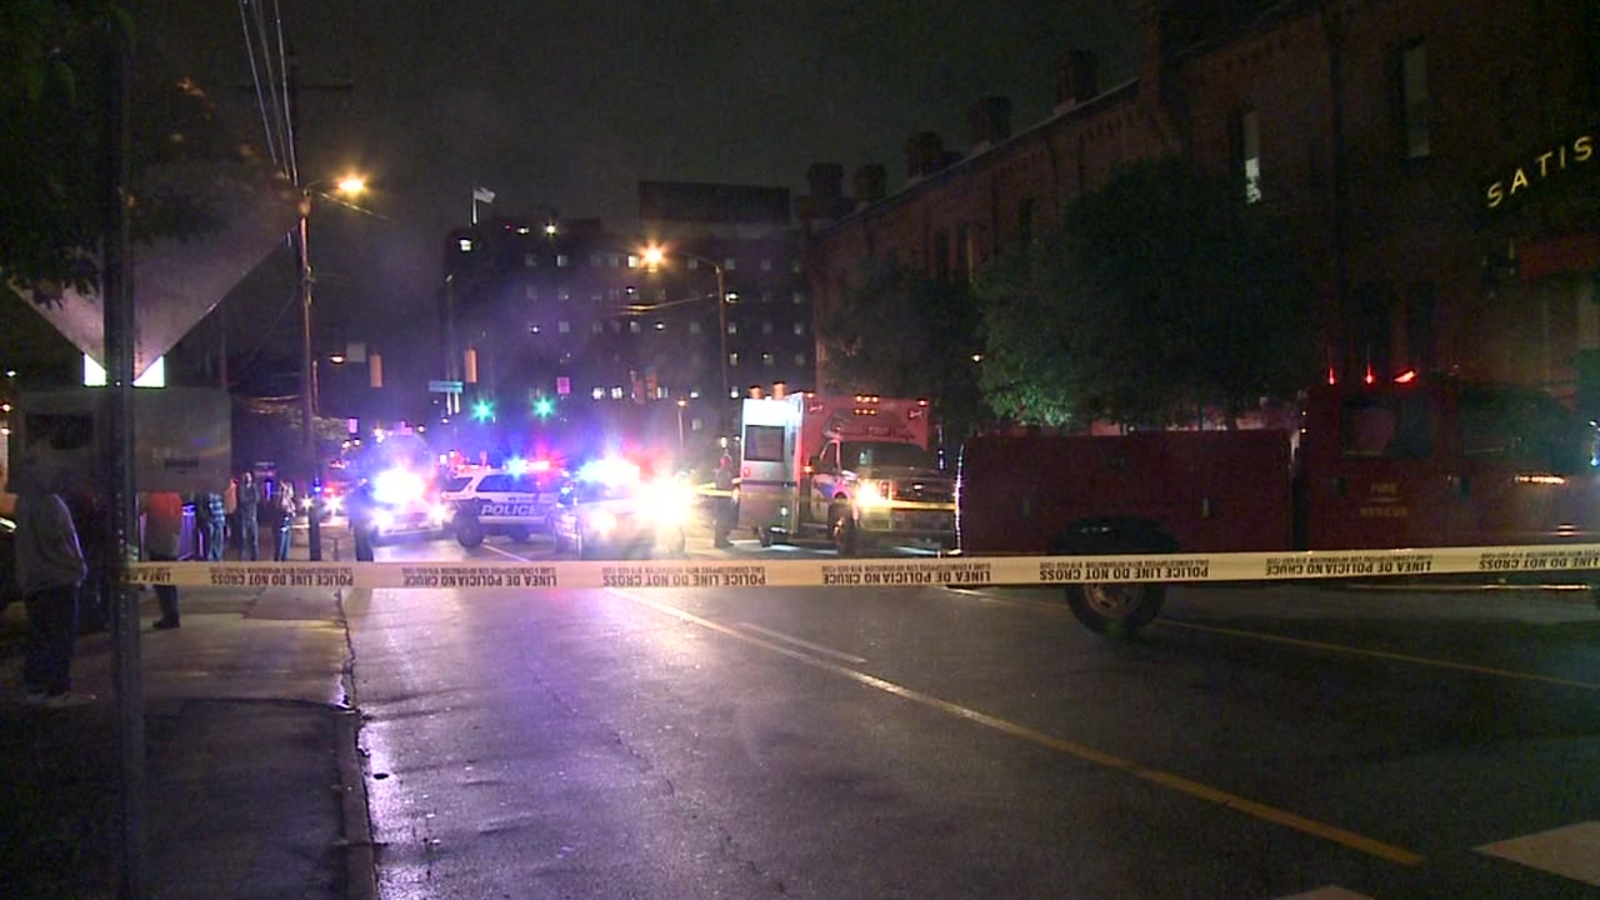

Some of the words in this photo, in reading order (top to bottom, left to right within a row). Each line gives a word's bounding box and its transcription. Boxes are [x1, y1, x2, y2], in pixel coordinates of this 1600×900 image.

[1486, 135, 1593, 208] SATIS
[481, 504, 538, 516] POLICE
[1376, 562, 1394, 573] DE
[1396, 561, 1432, 573] LINEA
[1478, 559, 1520, 571] CROSS
[1522, 558, 1548, 569] NOT
[1549, 558, 1569, 569] DO
[934, 571, 952, 584] DE
[954, 571, 991, 584] LINEA
[1039, 569, 1082, 582] CROSS
[1085, 569, 1110, 581] NOT
[1112, 568, 1131, 580] DO
[1133, 567, 1161, 580] LINE
[1165, 567, 1210, 579] POLICE
[1263, 565, 1304, 578] CRUCE
[210, 575, 244, 586] CROSS
[248, 575, 269, 586] NOT
[271, 575, 287, 586] DO
[290, 575, 313, 586] LINE
[315, 575, 353, 586] POLICE
[402, 575, 438, 588] CRUCE
[458, 575, 502, 588] POLICIA
[506, 575, 521, 588] DE
[523, 575, 557, 588] LINEA
[602, 575, 642, 588] CROSS
[645, 575, 669, 588] NOT
[672, 575, 690, 588] DO
[692, 575, 719, 587] LINE
[722, 575, 766, 587] POLICE
[822, 573, 861, 585] CRUCE
[882, 572, 932, 584] POLICIA
